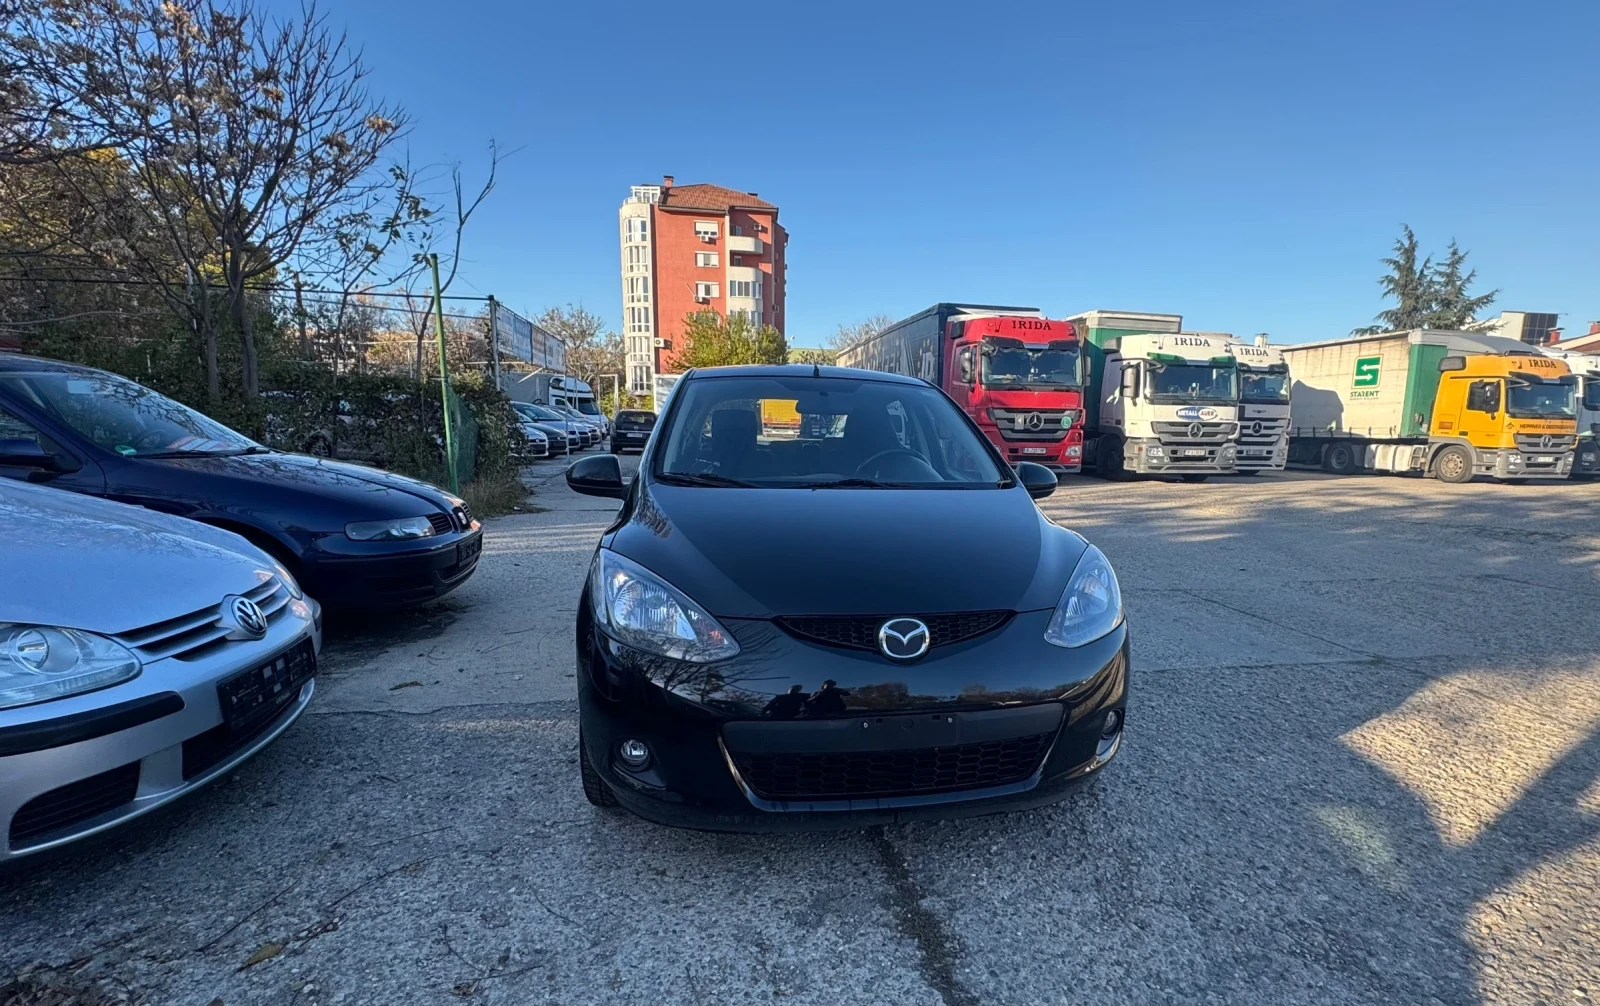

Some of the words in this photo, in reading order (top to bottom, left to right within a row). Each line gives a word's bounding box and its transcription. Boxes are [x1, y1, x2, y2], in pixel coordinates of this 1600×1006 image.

[1012, 320, 1051, 330] IRIDA
[1174, 337, 1211, 347] IRIDA
[1240, 348, 1269, 357] IRIDA
[1528, 359, 1557, 369] IRIDA
